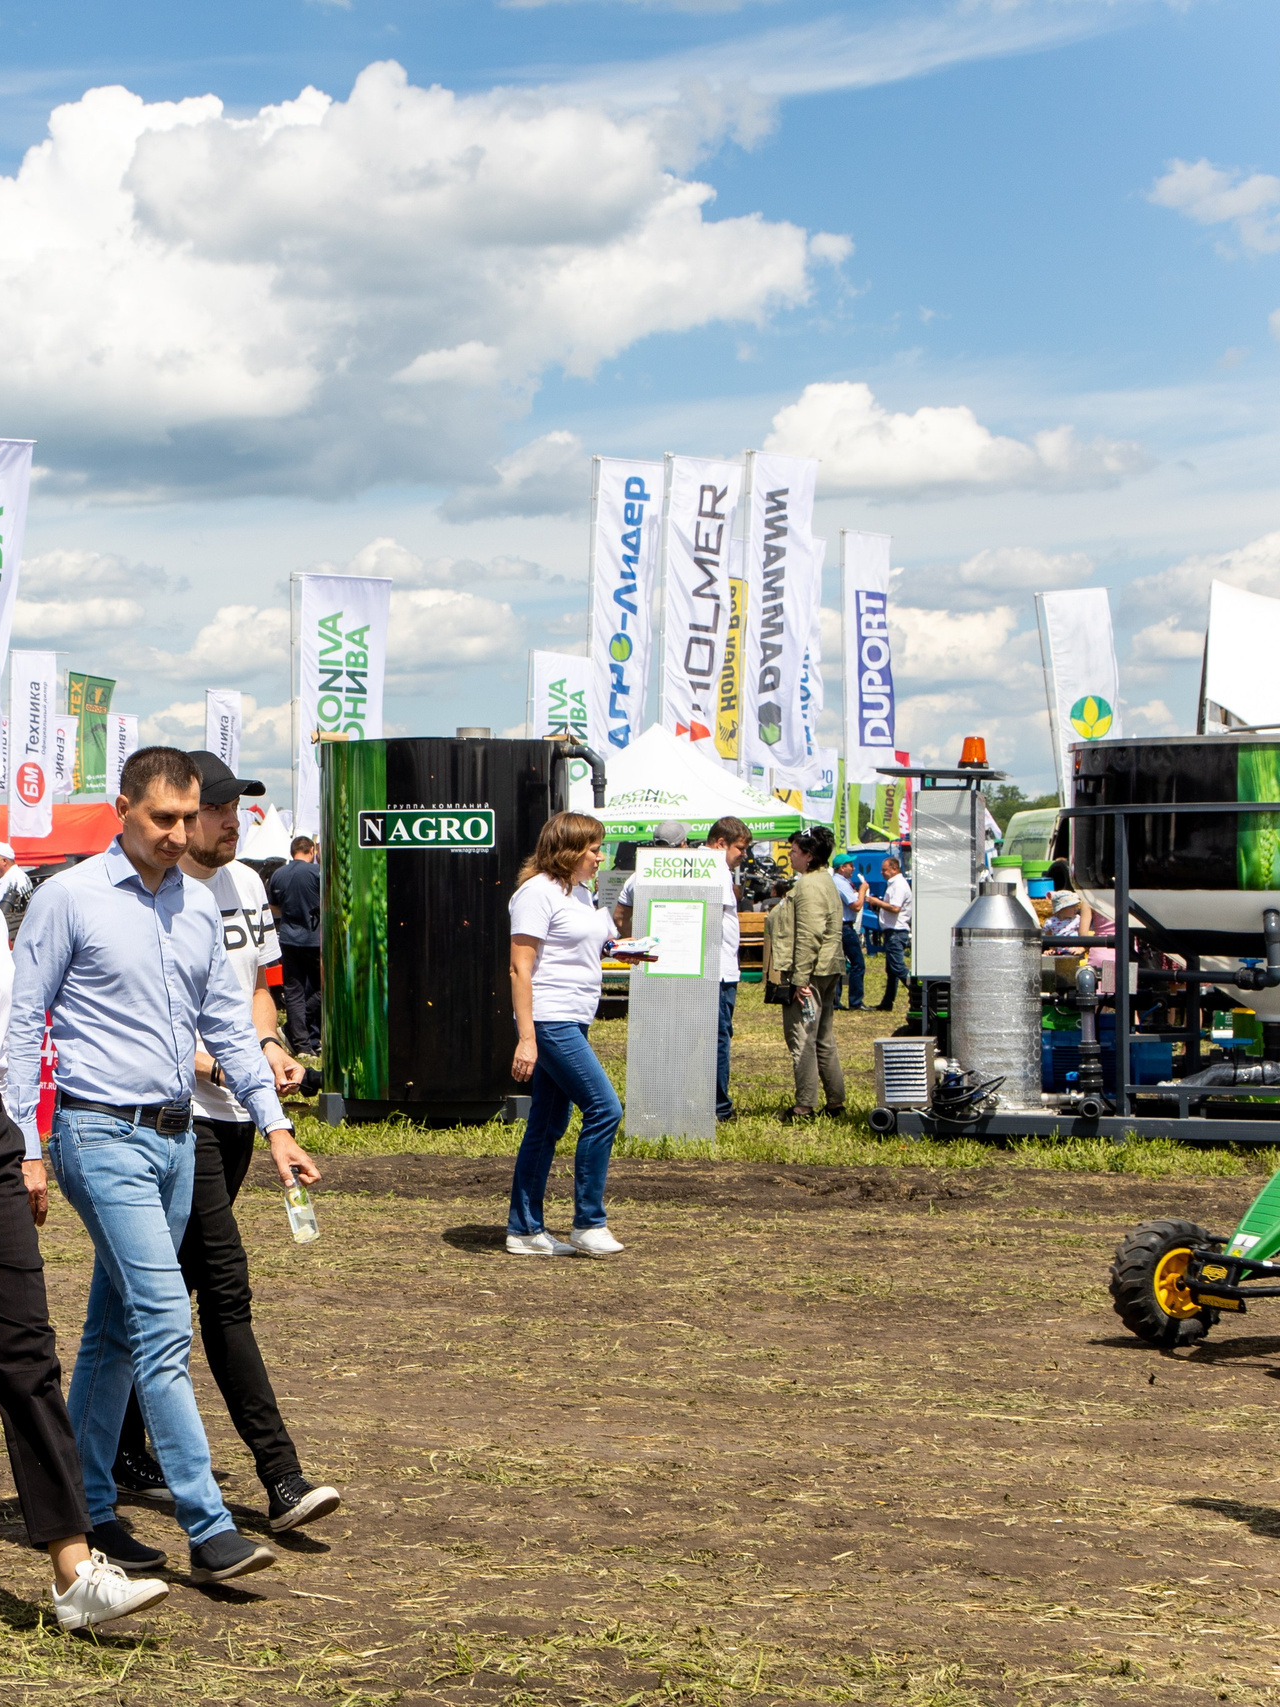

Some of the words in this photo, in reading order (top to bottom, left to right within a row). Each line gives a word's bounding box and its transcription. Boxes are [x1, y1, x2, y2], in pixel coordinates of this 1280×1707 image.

[859, 590, 892, 746] DUPORT
[26, 681, 40, 755] Техника
[55, 728, 65, 780] СЕРВИС
[117, 717, 127, 789] НАВИГАЦ
[23, 766, 39, 798] БМ
[431, 802, 490, 810] КОМПАНИЙ
[604, 795, 680, 808] КОНИВА
[643, 867, 711, 879] ЭКОНИВА
[653, 857, 717, 868] EKONIVA
